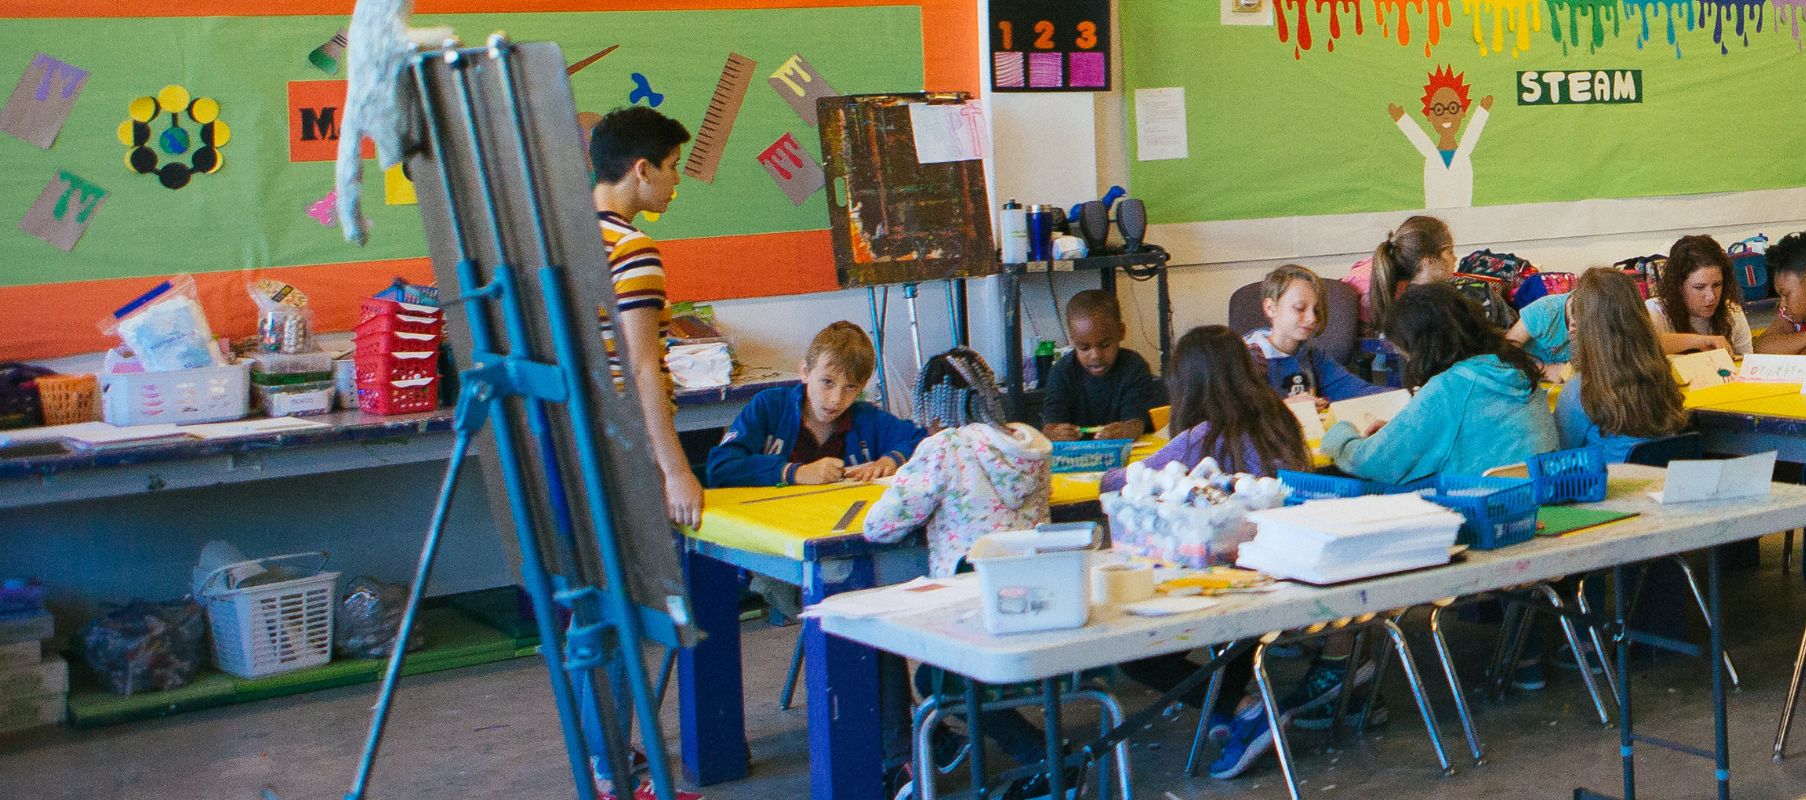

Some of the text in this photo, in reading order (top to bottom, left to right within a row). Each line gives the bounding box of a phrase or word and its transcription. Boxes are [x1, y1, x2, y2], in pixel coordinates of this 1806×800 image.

[998, 20, 1097, 49] 1 2 3
[1521, 70, 1636, 103] STEAM
